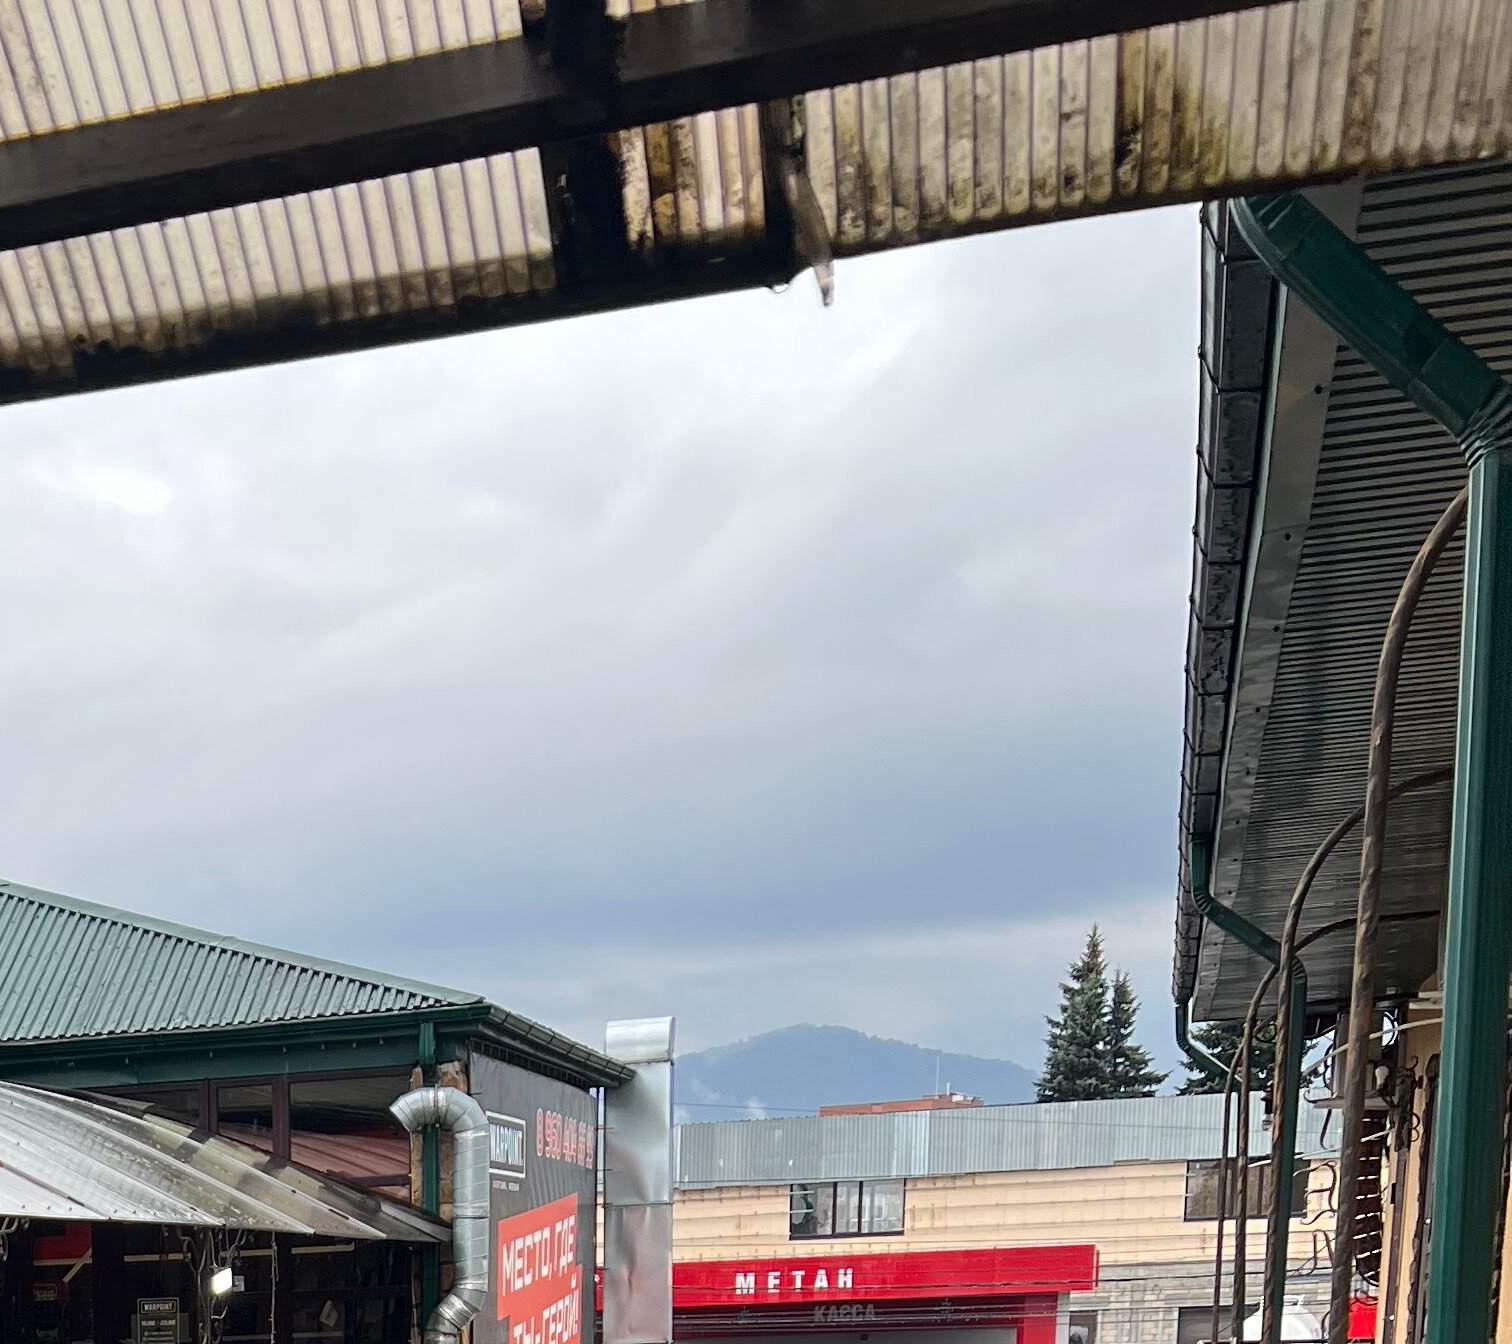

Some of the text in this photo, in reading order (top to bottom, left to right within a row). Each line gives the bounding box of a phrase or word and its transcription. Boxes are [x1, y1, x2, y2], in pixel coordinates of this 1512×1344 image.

[536, 1108, 544, 1157] 8
[502, 1214, 576, 1296] МЕСТО, ГДЕ
[735, 1268, 853, 1295] МЕТАН
[814, 1304, 875, 1322] КАССА
